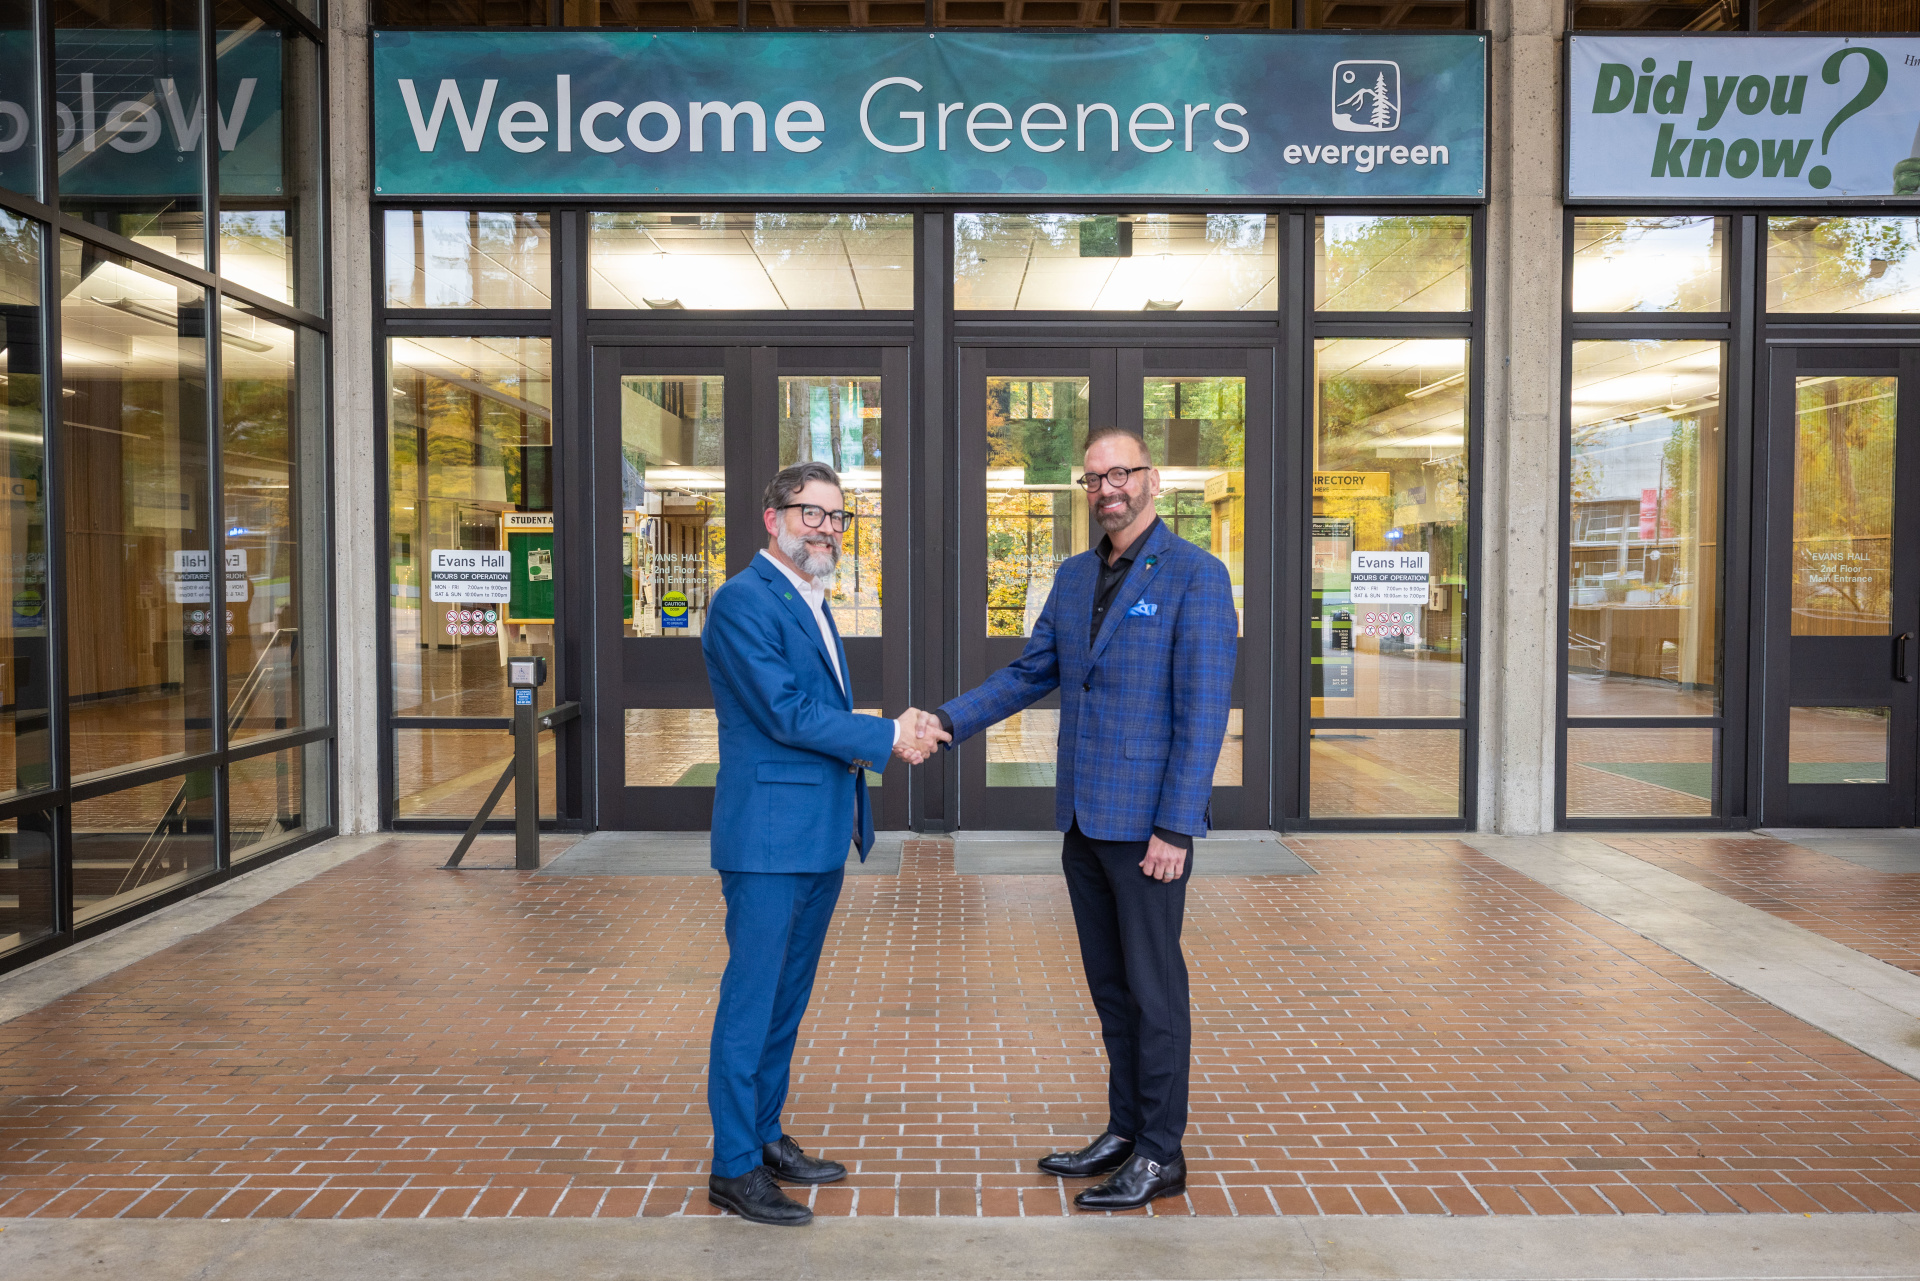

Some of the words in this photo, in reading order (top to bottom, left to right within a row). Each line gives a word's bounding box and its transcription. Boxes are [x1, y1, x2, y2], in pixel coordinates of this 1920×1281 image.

[1592, 57, 1693, 115] Did
[1697, 74, 1808, 131] you
[397, 74, 826, 153] Welcome
[859, 76, 1250, 153] Greeners
[1283, 144, 1450, 174] evergreen
[1313, 476, 1366, 485] IRECTORY
[510, 516, 547, 524] STUDENT
[438, 554, 476, 567] Evans
[481, 555, 505, 567] Hall
[681, 553, 706, 562] HALL
[1812, 552, 1844, 561] EVANS
[1847, 552, 1871, 561] HALL
[1358, 556, 1395, 568] Evans
[1400, 556, 1423, 568] Hall
[654, 566, 671, 574] 2nd
[673, 566, 697, 574] Floor
[1820, 564, 1837, 573] 2nd
[1840, 564, 1862, 573] Floor
[667, 576, 708, 584] Entrance
[1809, 574, 1831, 583] Main
[1834, 574, 1873, 583] Entrance
